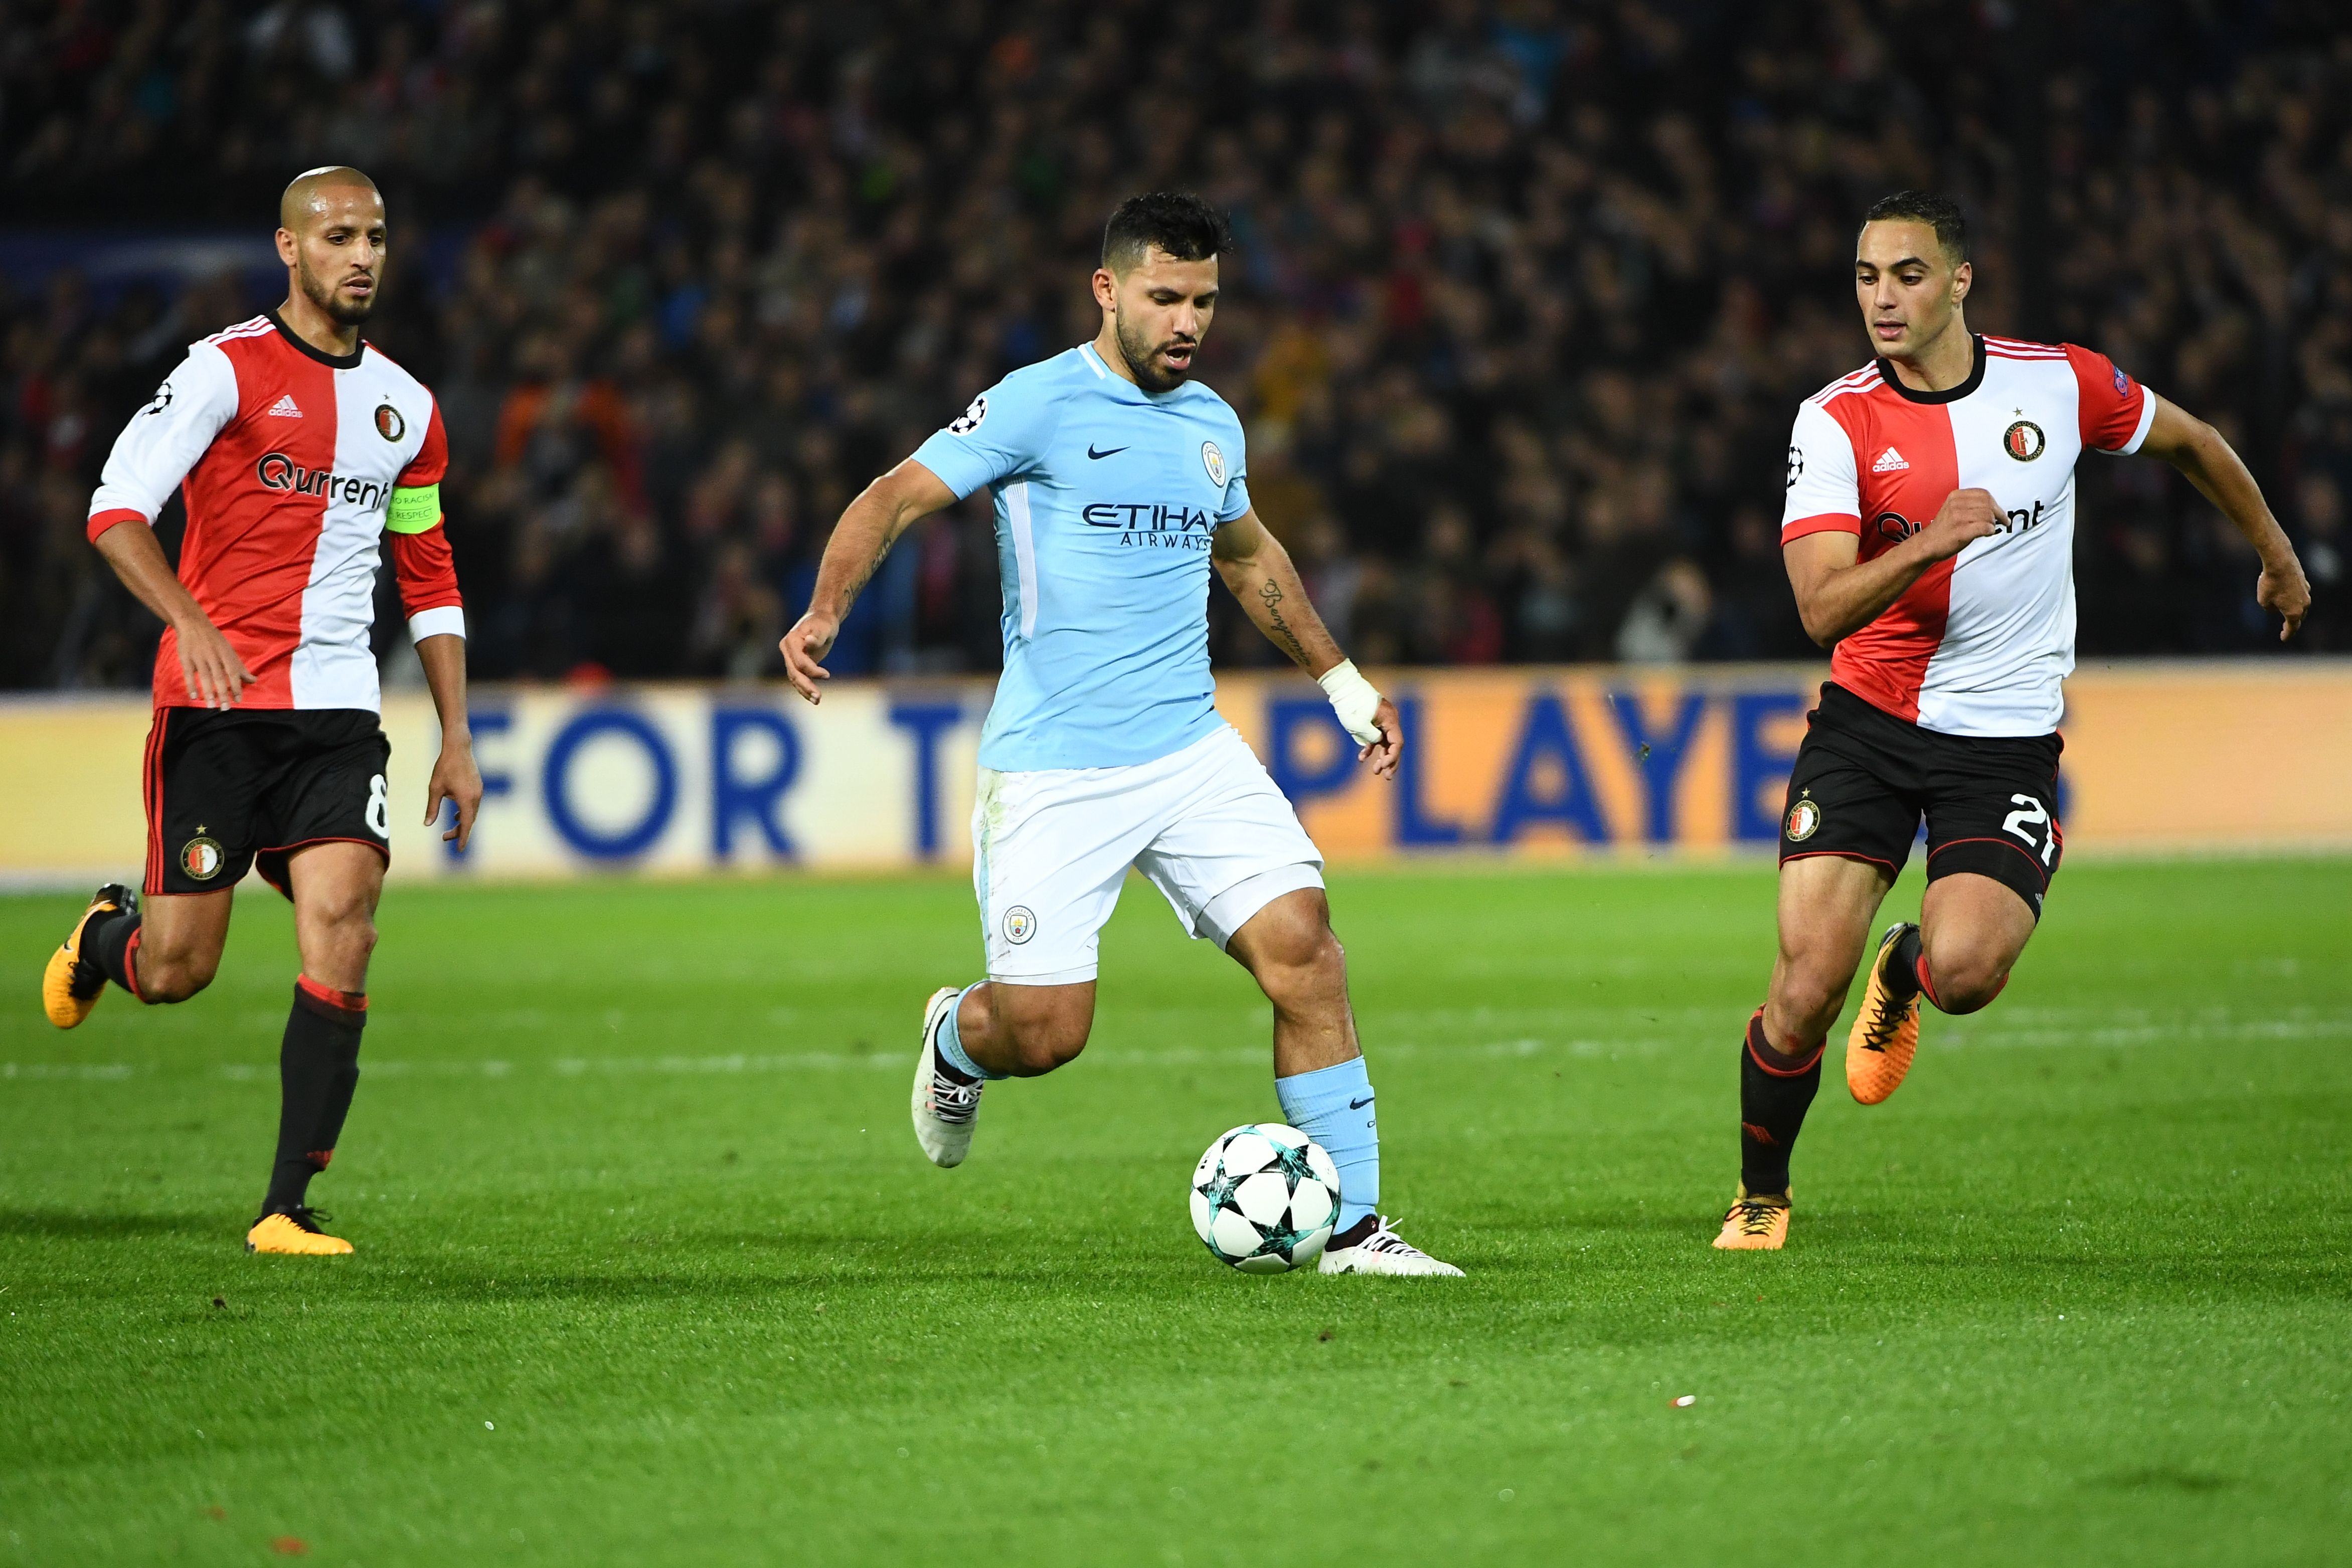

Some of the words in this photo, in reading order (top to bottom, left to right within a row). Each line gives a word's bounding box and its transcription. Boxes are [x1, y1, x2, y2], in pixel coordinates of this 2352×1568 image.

[268, 409, 303, 418] adidas
[2006, 422, 2040, 437] FEYENOORD
[2008, 445, 2043, 461] ROTTERDAM
[1873, 461, 1910, 472] adidas
[258, 453, 389, 509] Qurrent
[396, 507, 433, 519] RESPECT
[1082, 503, 1218, 536] ETIHA
[1120, 532, 1208, 551] AIRWAYS
[444, 706, 802, 863] FOR
[889, 705, 963, 855] T
[1269, 689, 2076, 847] PLAYE
[365, 774, 390, 839] 8
[2002, 793, 2055, 867] 21
[1006, 909, 1033, 921] MANCHESTER
